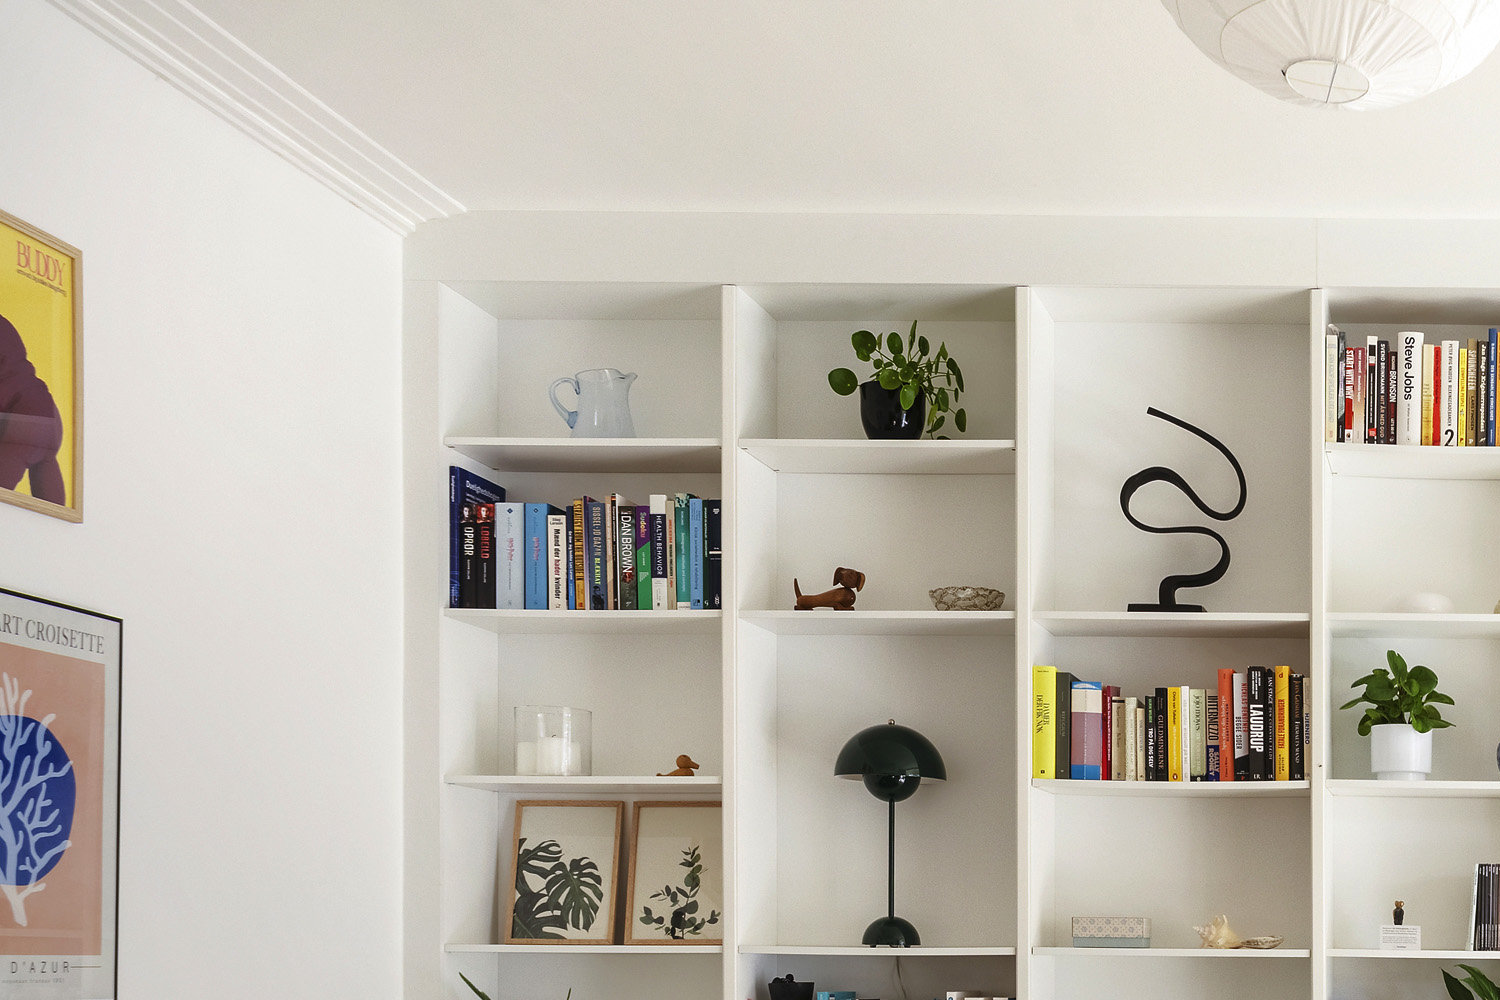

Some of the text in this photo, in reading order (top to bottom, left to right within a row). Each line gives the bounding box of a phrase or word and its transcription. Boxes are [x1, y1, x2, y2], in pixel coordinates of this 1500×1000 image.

[16, 240, 66, 286] BUDDY
[1345, 350, 1354, 399] START WITH WHY
[1404, 337, 1416, 401] Steve Jobs
[1389, 370, 1397, 403] BRANSON
[464, 526, 474, 556] OPRØR
[640, 512, 648, 538] Sudoku
[554, 547, 562, 558] der
[621, 515, 633, 573] DAN BROWN
[554, 559, 562, 576] hader
[554, 577, 562, 600] kvinder
[0, 613, 104, 654] RT CROISETTE
[1207, 695, 1219, 741] INTERMEZZO
[1250, 704, 1264, 753] LAUDRUP
[1148, 738, 1155, 746] PÅ
[10, 961, 70, 974] D'AZUR
